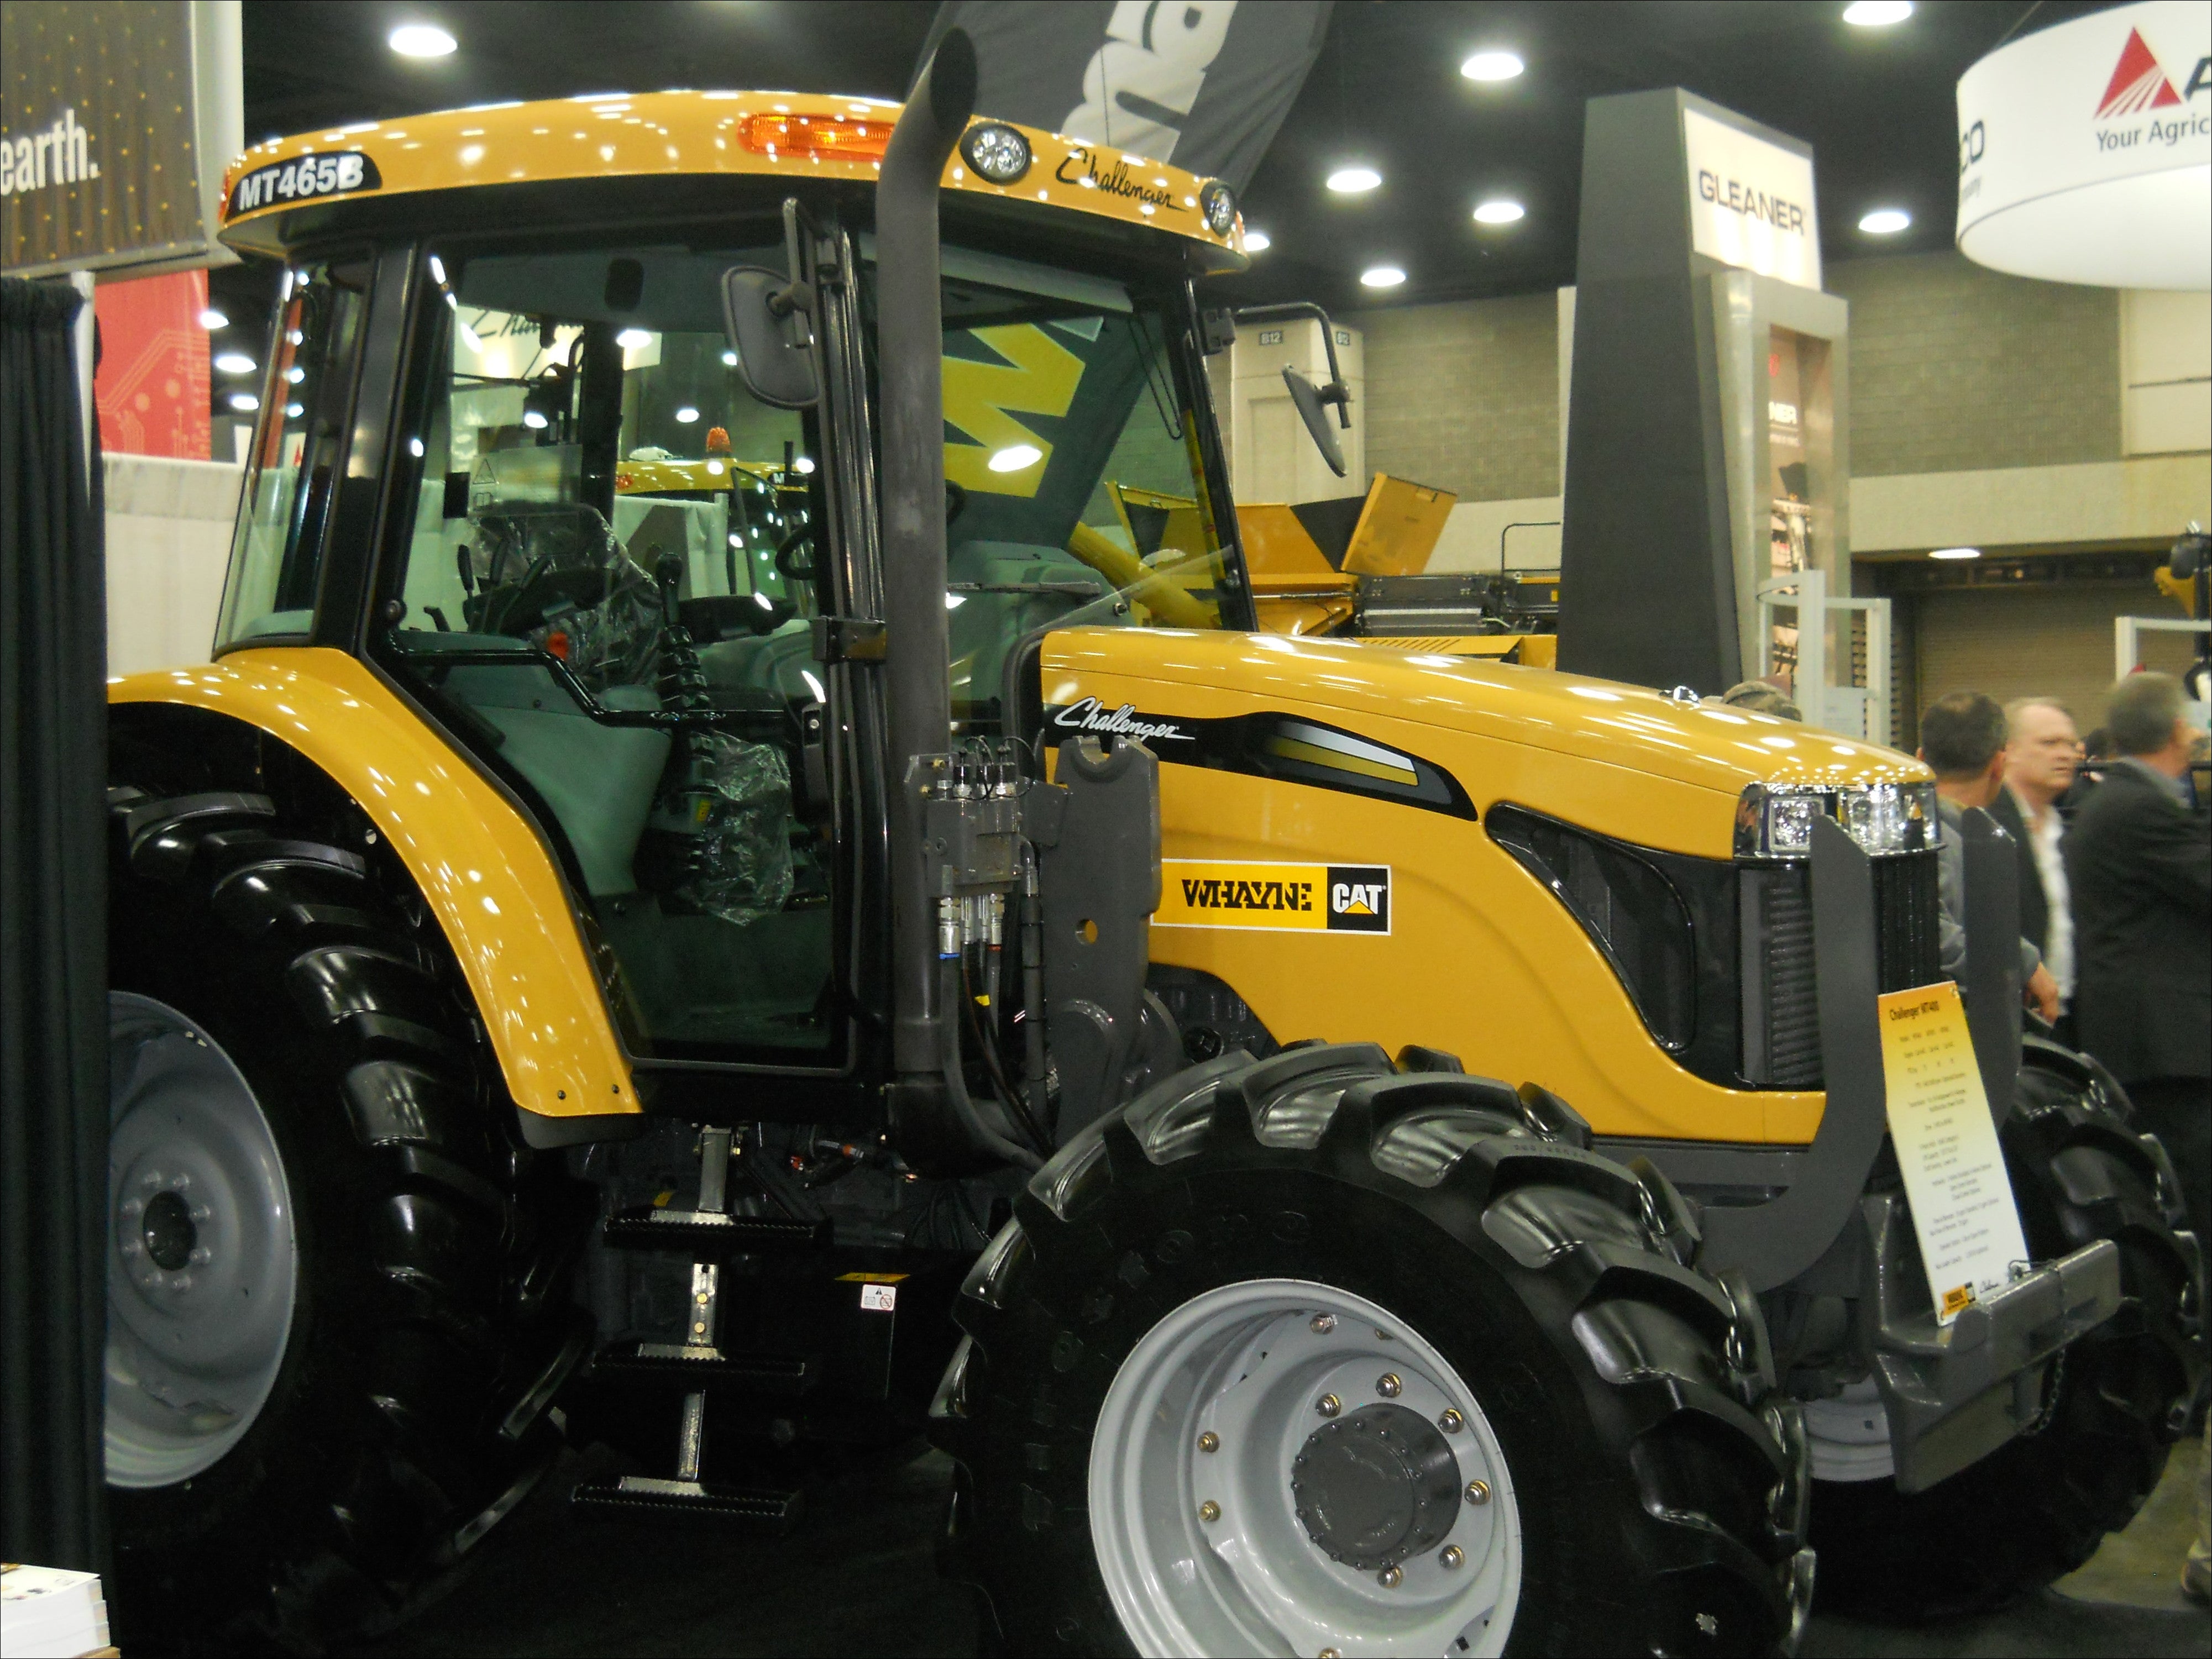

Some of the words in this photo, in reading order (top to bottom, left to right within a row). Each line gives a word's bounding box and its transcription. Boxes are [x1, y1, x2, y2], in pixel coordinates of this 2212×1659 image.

[1, 108, 100, 195] earth.
[2096, 128, 2141, 153] Your
[240, 155, 364, 211] MT465B
[1056, 148, 1189, 216] Challenger
[1699, 169, 1804, 236] GLEANER
[1055, 696, 1195, 742] Challenger
[1181, 879, 1312, 911] WHAYNE
[1333, 884, 1383, 914] CAT
